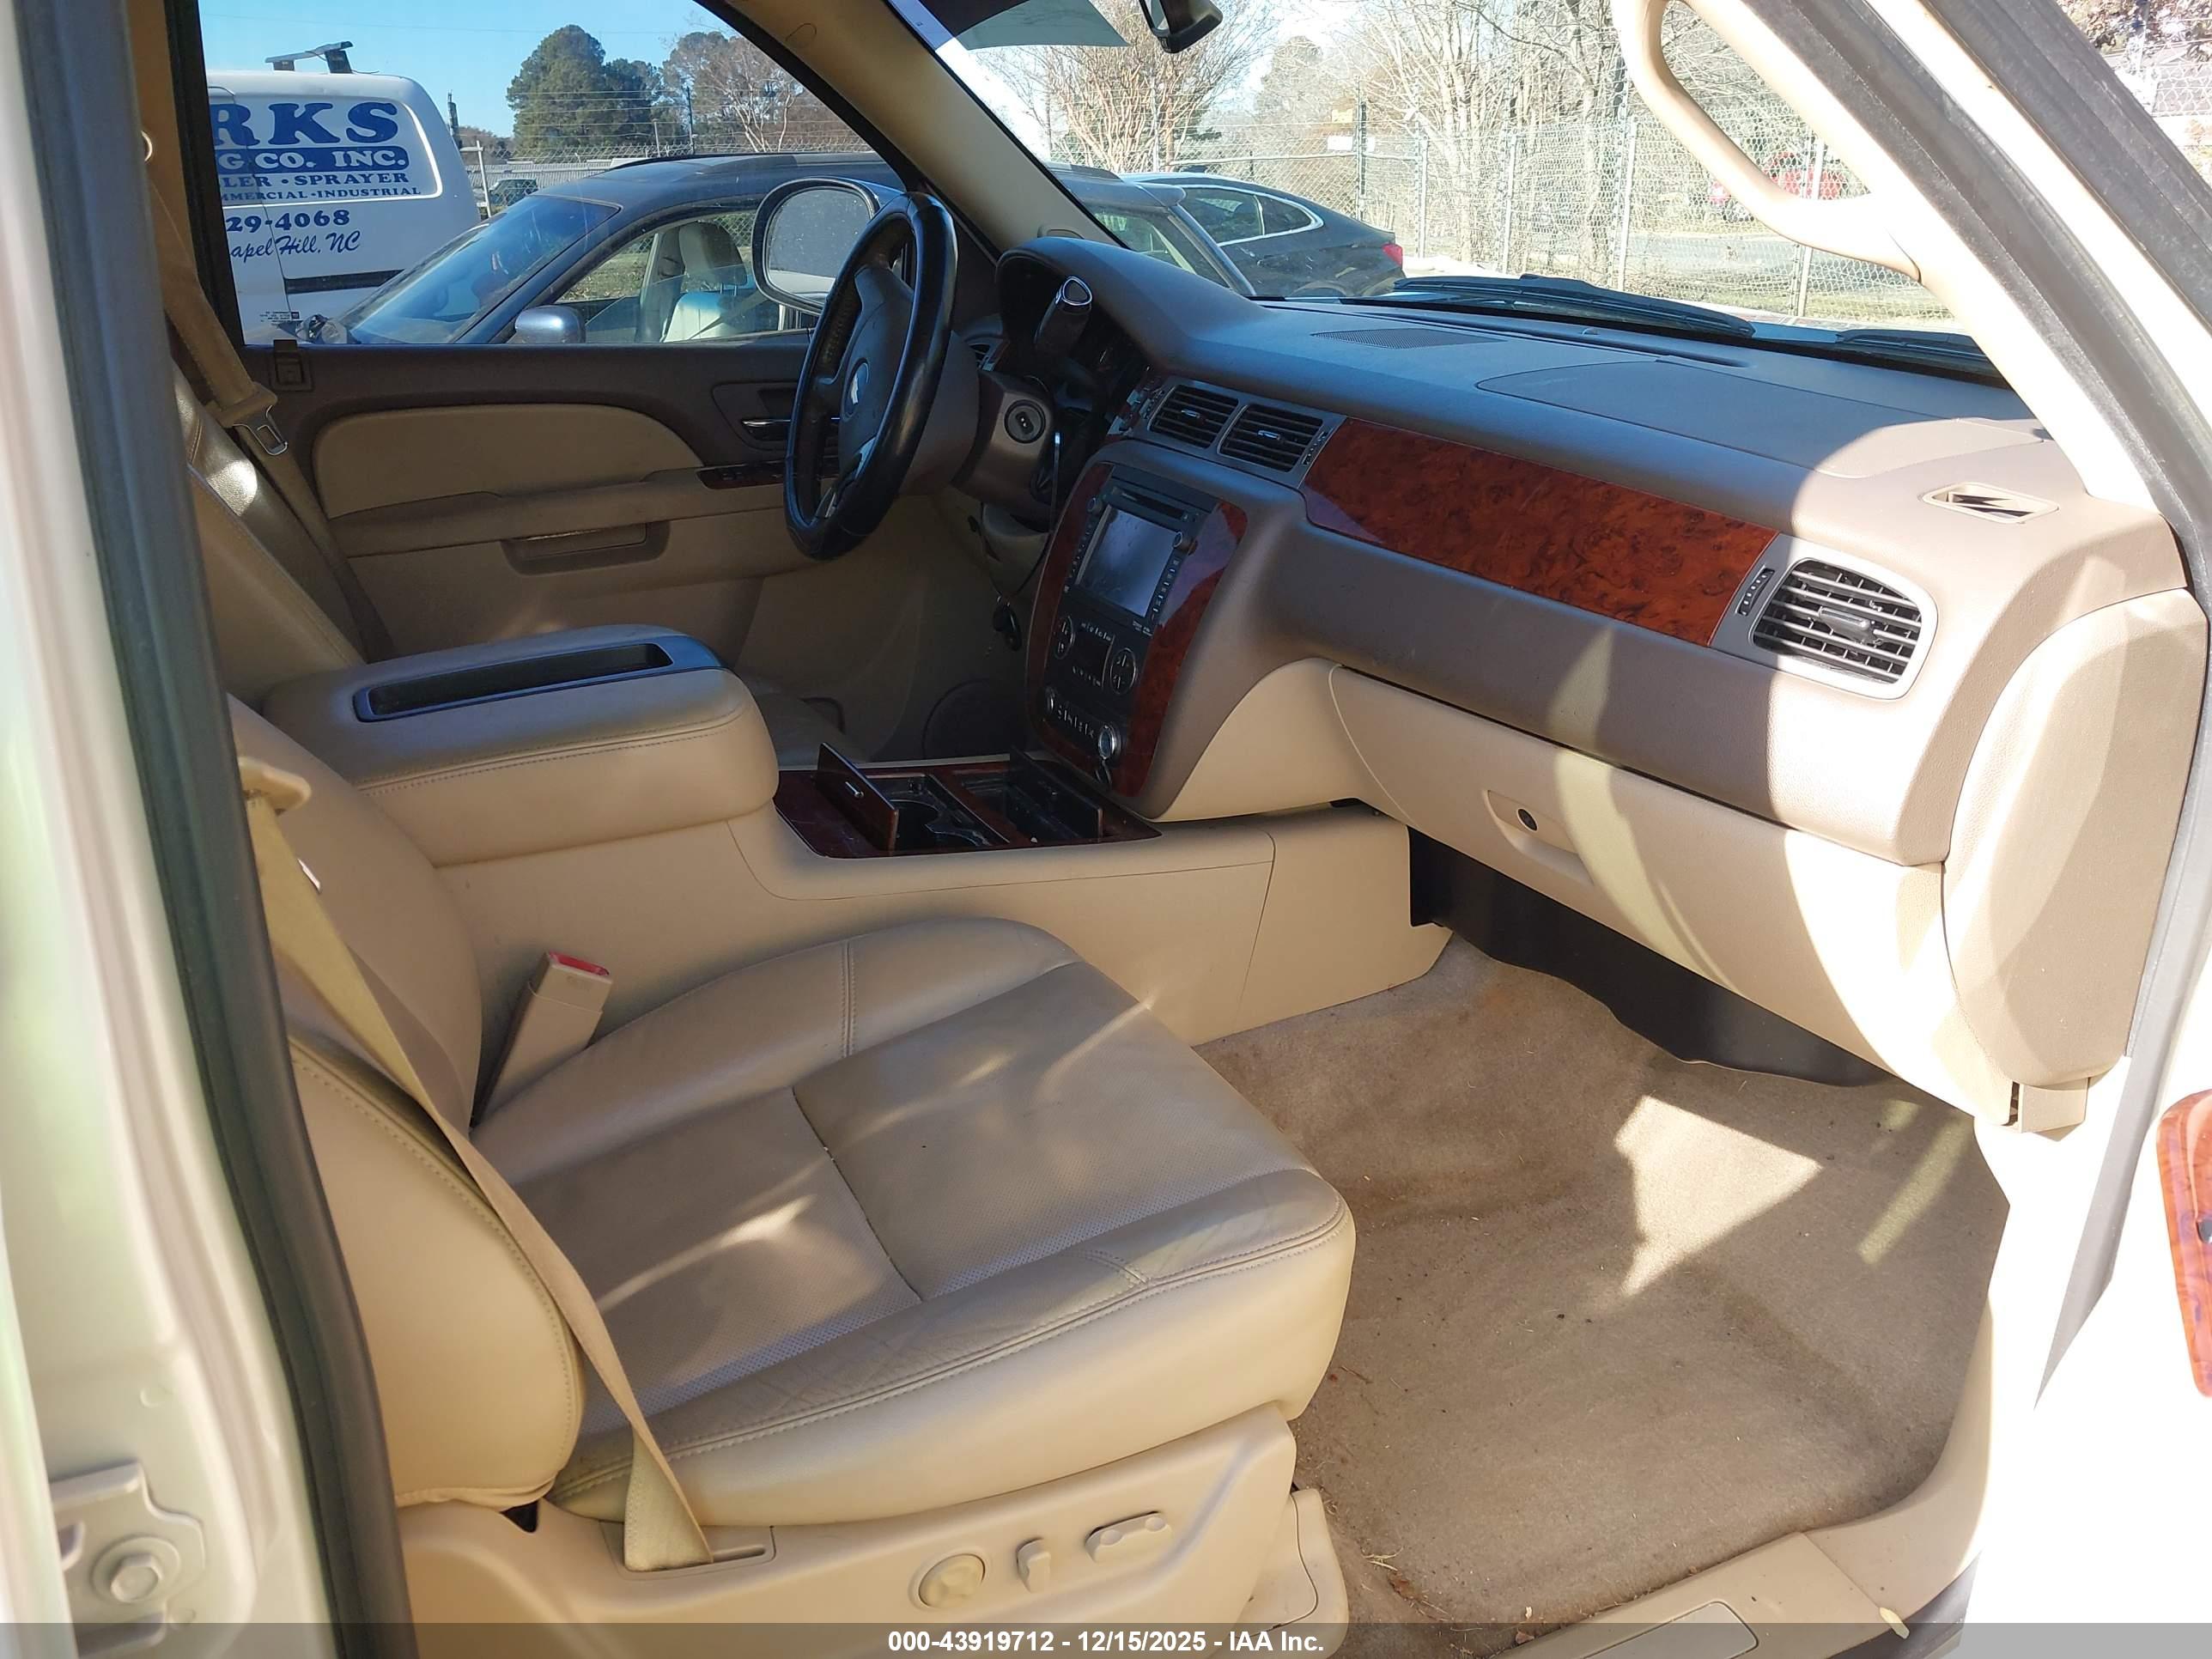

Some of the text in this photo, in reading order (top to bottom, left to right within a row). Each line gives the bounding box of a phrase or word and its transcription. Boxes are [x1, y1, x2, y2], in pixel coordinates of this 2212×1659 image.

[331, 149, 406, 167] INC.
[295, 173, 410, 185] SPRAYER
[225, 210, 350, 233] 29-4068
[325, 230, 362, 253] NC
